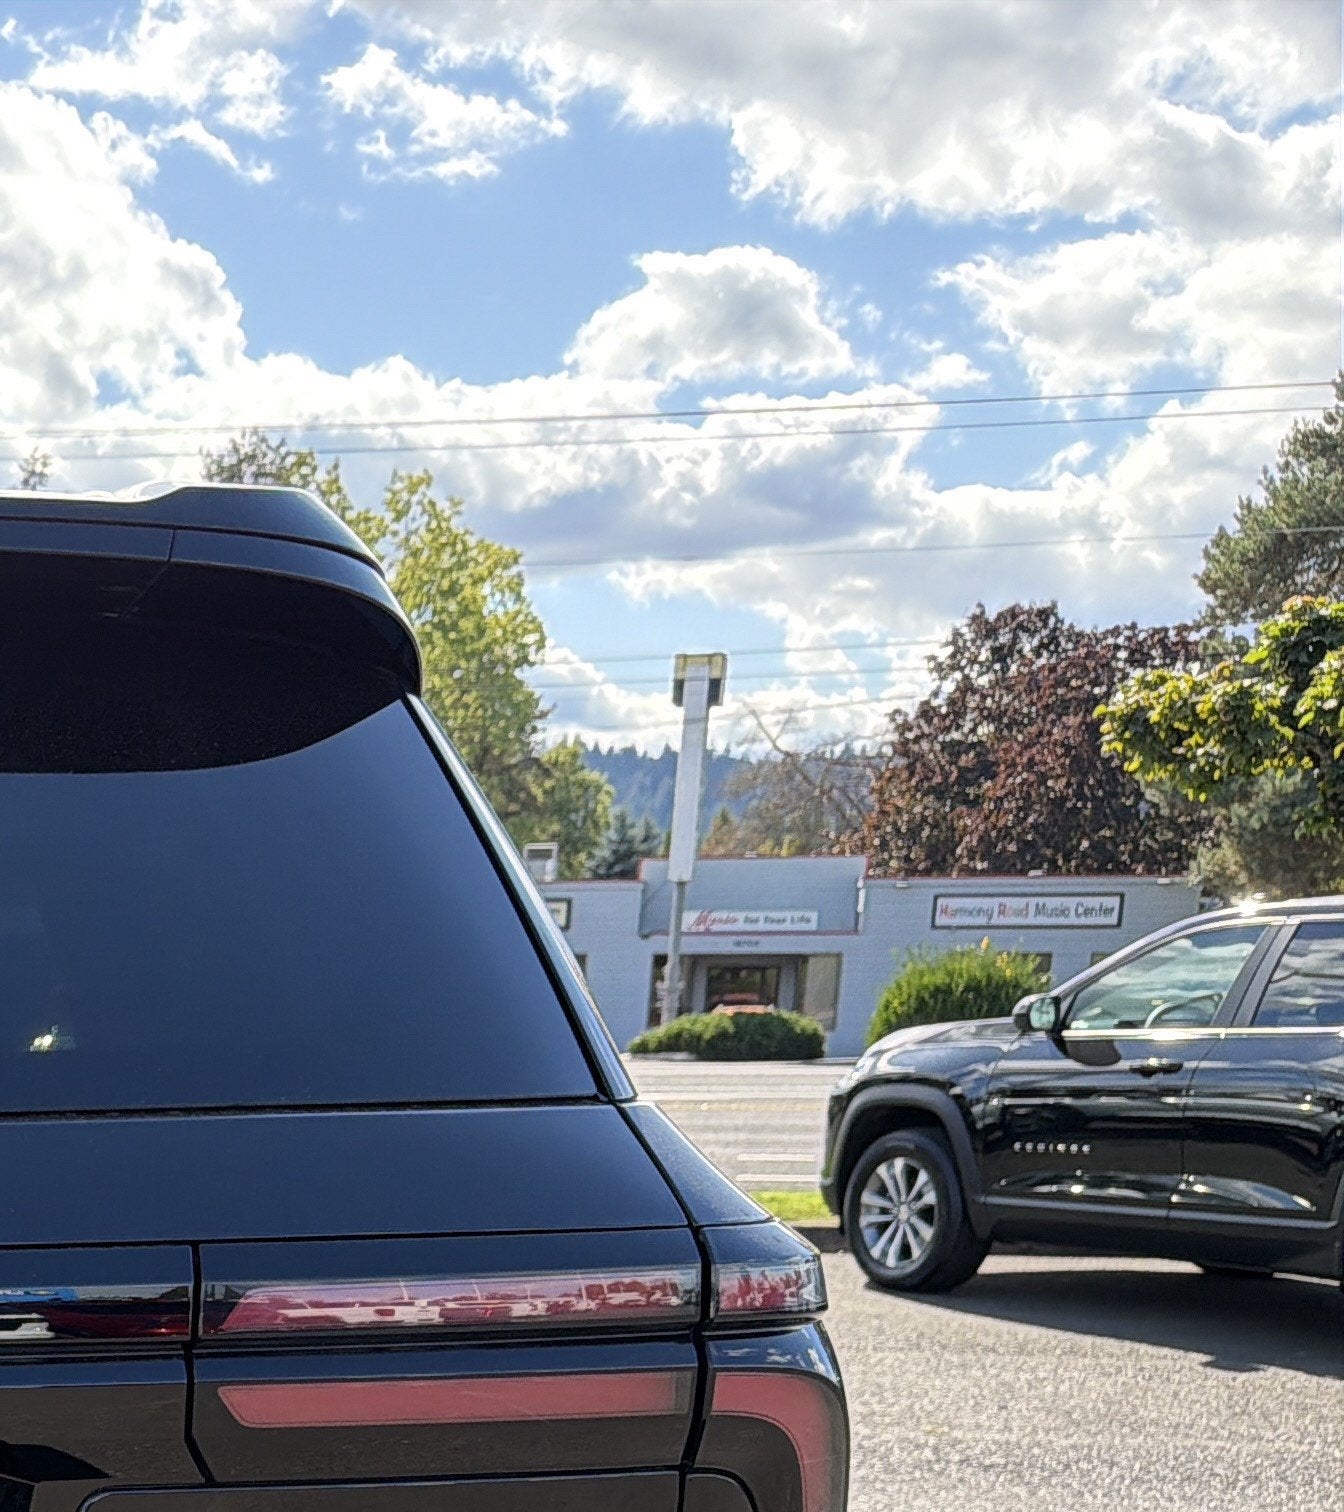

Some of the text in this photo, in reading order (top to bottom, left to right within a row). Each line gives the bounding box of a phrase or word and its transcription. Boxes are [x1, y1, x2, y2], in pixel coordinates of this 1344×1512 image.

[939, 903, 994, 924] Harmony
[1034, 902, 1071, 919] Music
[1075, 902, 1115, 919] Center
